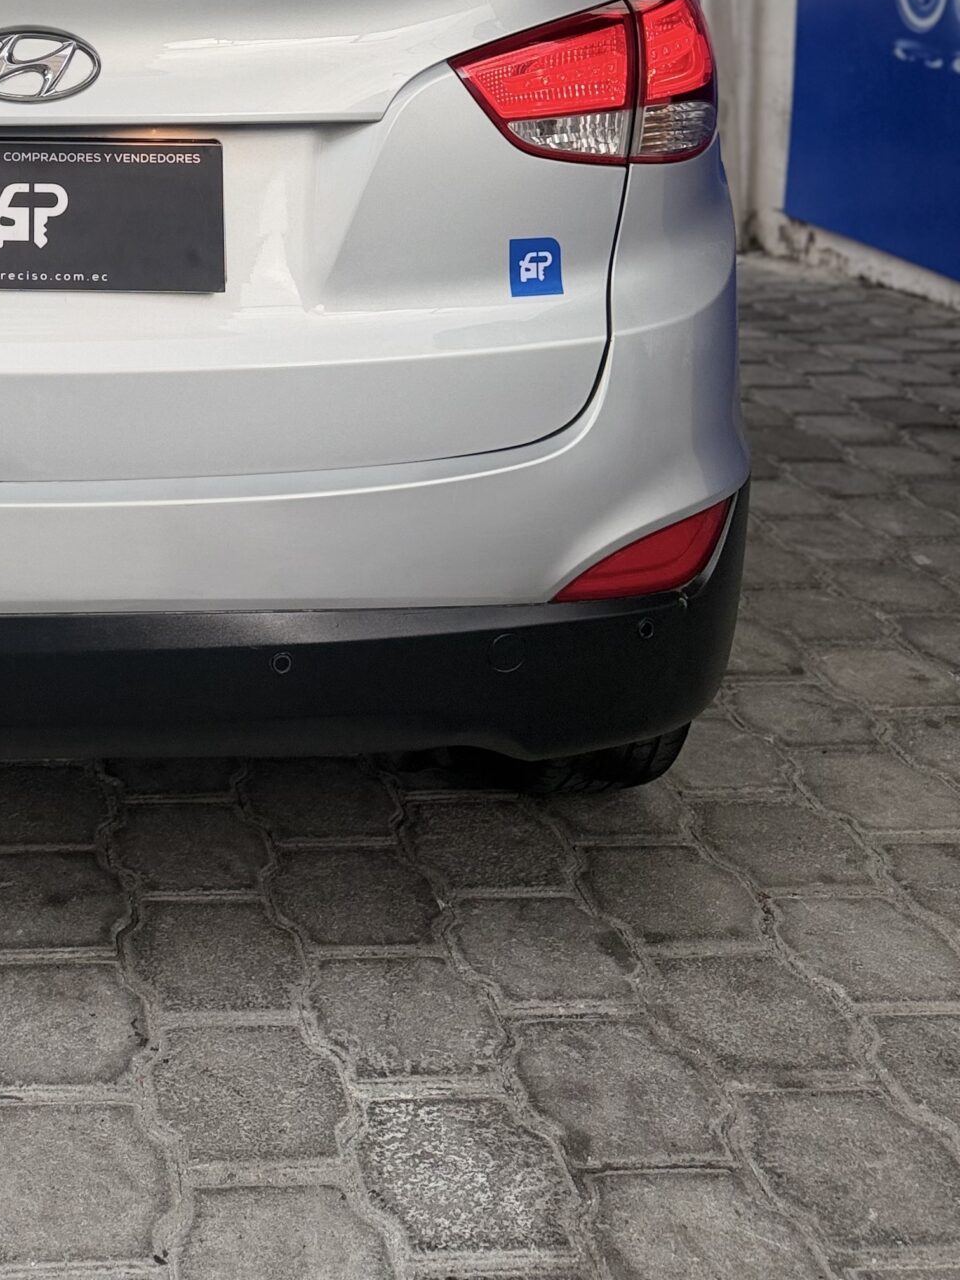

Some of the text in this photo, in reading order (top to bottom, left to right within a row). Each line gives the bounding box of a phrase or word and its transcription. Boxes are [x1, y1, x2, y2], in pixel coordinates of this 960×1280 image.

[3, 152, 102, 163] COMPRADORES
[104, 153, 112, 162] Y
[114, 153, 201, 164] VENDEDORES
